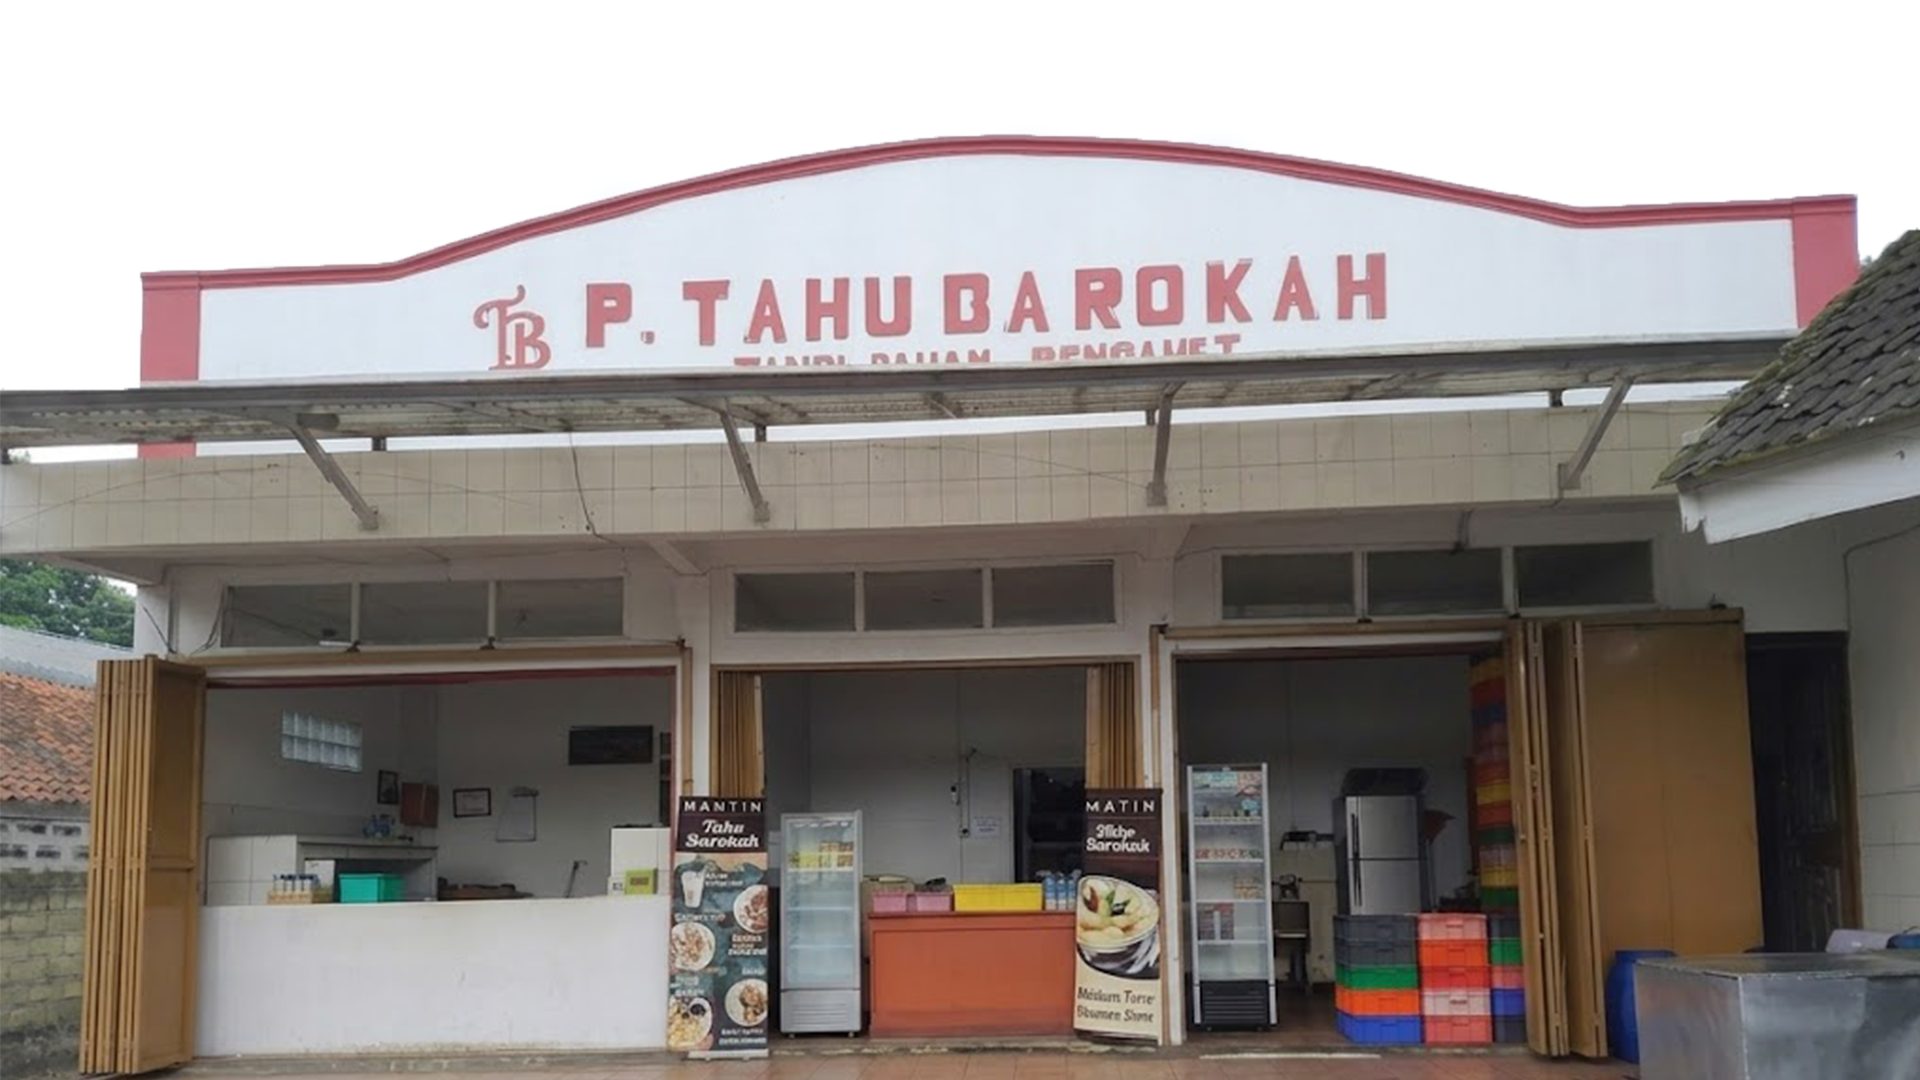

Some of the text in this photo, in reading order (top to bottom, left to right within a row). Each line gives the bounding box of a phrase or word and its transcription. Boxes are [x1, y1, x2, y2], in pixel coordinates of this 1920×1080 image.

[682, 276, 913, 346] TAHU
[942, 253, 1388, 335] BAROKAH
[683, 801, 762, 813] MANTIN
[1085, 800, 1155, 813] MATIN
